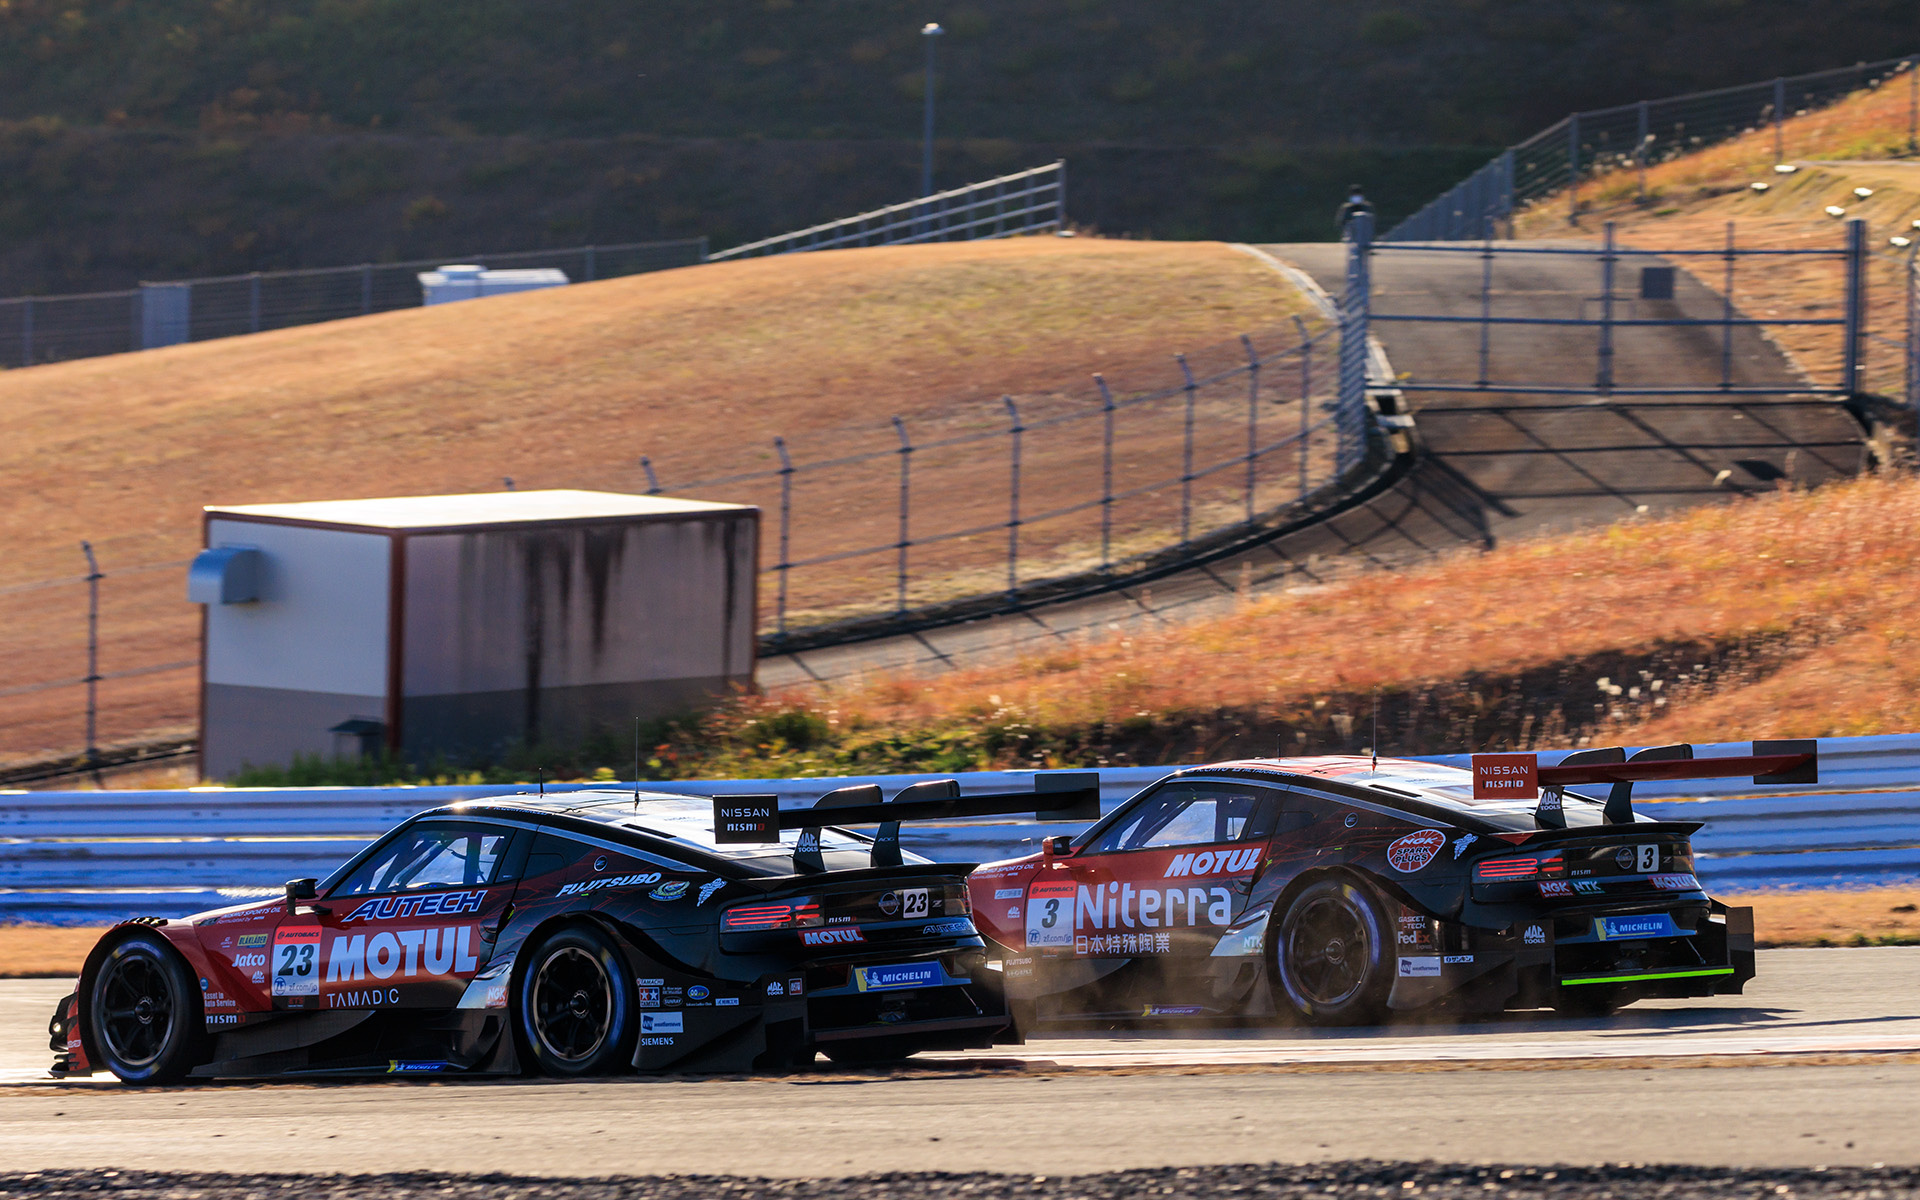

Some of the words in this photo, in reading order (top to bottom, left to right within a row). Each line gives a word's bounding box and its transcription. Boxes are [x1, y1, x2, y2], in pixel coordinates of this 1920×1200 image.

[1480, 766, 1528, 775] NISSAN
[1541, 791, 1561, 805] MAC
[721, 808, 770, 817] NISSAN
[798, 832, 818, 846] MAC
[1399, 837, 1438, 846] NGK
[1396, 846, 1431, 855] SPARK
[1163, 848, 1262, 877] MOTUL
[1394, 854, 1428, 864] PLUGS
[1642, 847, 1654, 869] 3
[997, 865, 1023, 873] SPORTS
[555, 872, 662, 898] FUJITSUBO
[1540, 882, 1570, 893] NGK
[1573, 881, 1602, 892] NTK
[1652, 876, 1696, 889] MOTUL
[1039, 885, 1074, 894] AUTOBACS
[341, 890, 488, 922] AUTECH
[904, 893, 927, 914] 23
[1076, 881, 1232, 929] Niterra
[244, 908, 270, 916] SPORTS
[1041, 898, 1060, 928] 3
[923, 922, 967, 934] AUTECH
[1524, 925, 1546, 938] MAC
[1619, 922, 1663, 932] MICHELIN
[804, 928, 864, 944] MOTUL
[1043, 934, 1072, 943] zf.com/jp
[1243, 936, 1263, 948] NTK
[1397, 930, 1430, 944] FedEx
[1076, 932, 1170, 955] 日本特殊陶業
[232, 952, 265, 968] Jatco
[278, 944, 315, 976] 23
[326, 925, 481, 983] MOTUL
[1006, 957, 1032, 966] FUJITSUBO
[882, 970, 931, 983] MICHELIN
[289, 982, 318, 993] zf.com/jp
[487, 987, 506, 1001] NGK
[204, 992, 218, 1000] Asset
[326, 988, 400, 1008] TAMADIC
[216, 999, 236, 1007] Service
[641, 1037, 674, 1046] SIEMENS
